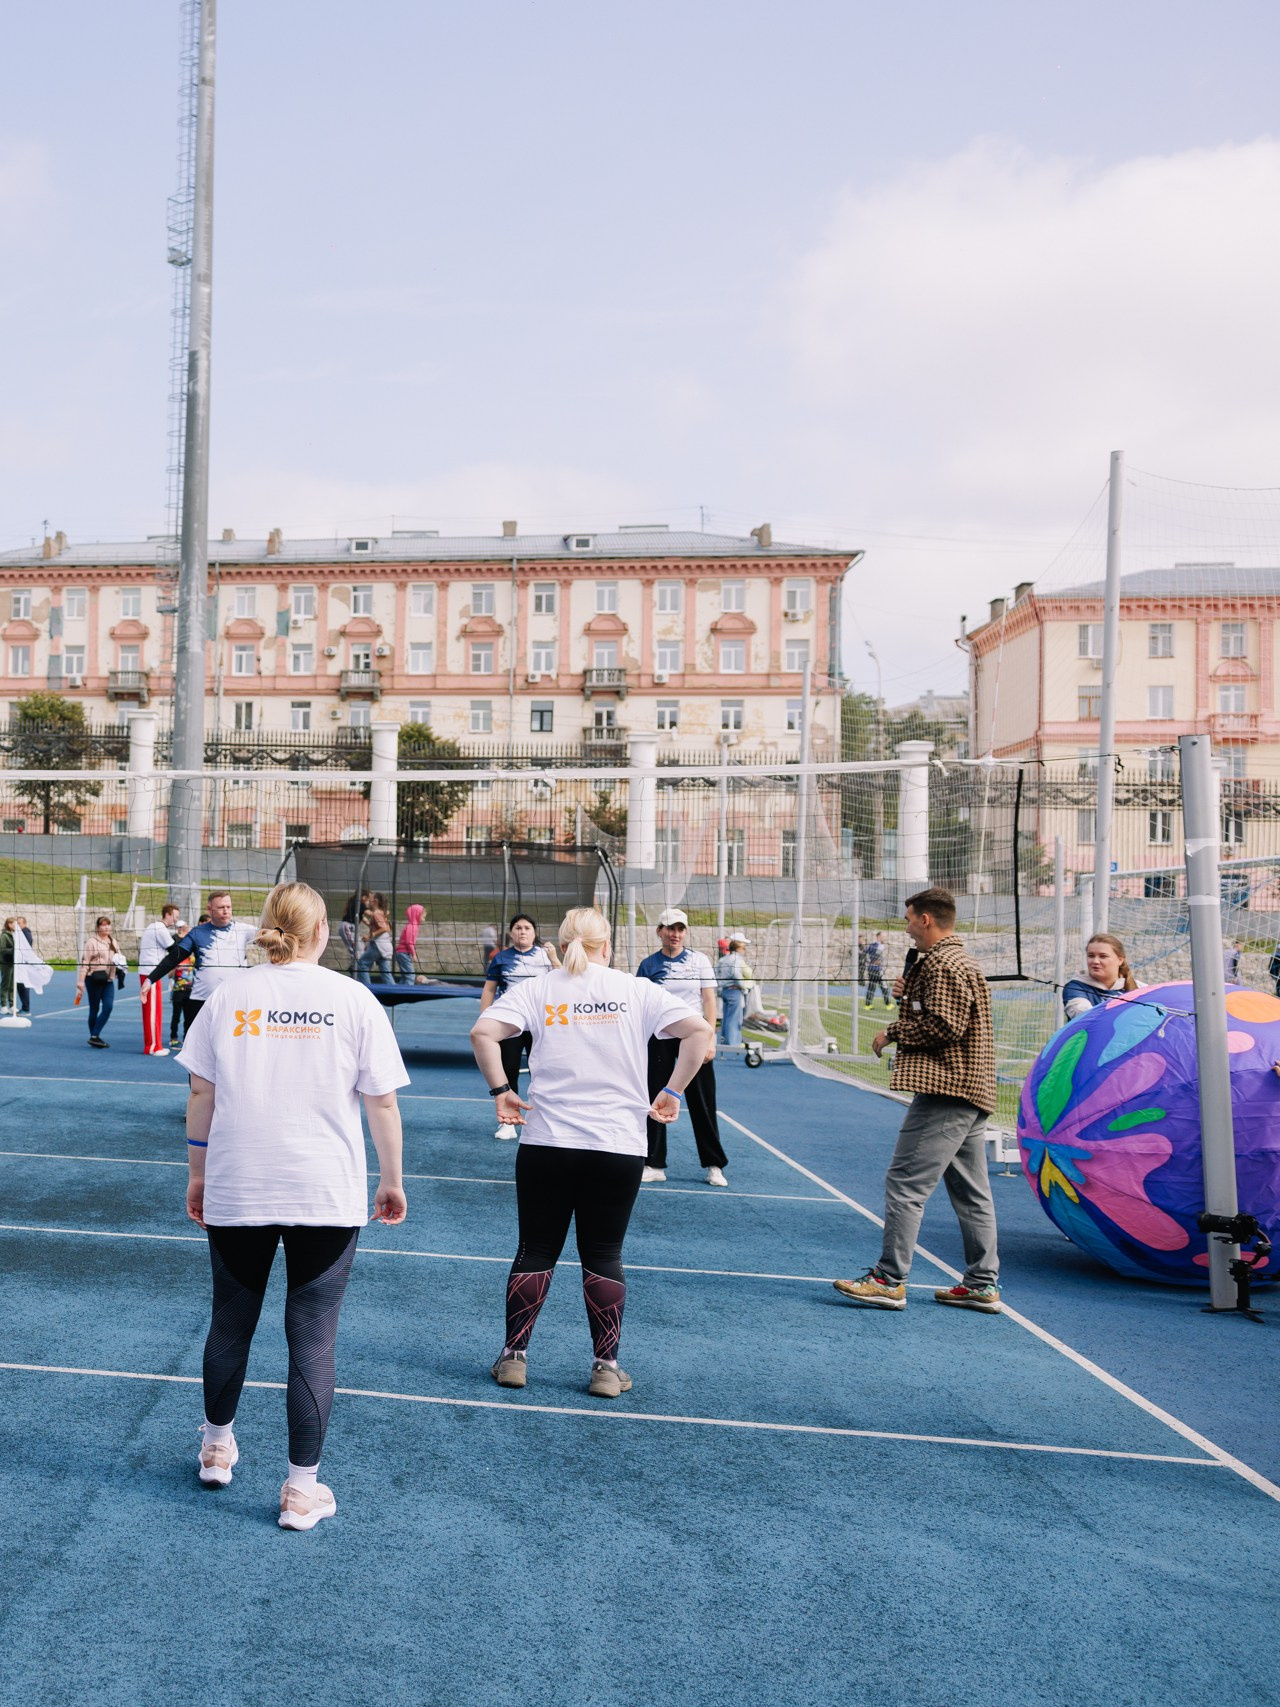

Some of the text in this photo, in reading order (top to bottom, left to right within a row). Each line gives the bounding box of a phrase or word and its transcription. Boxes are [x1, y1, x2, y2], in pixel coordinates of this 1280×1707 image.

[573, 1002, 627, 1014] КОМОС
[267, 1010, 334, 1026] КОМОС
[573, 1013, 619, 1021] ВАРАКСИНО
[266, 1025, 322, 1034] ВАРАКСИНО
